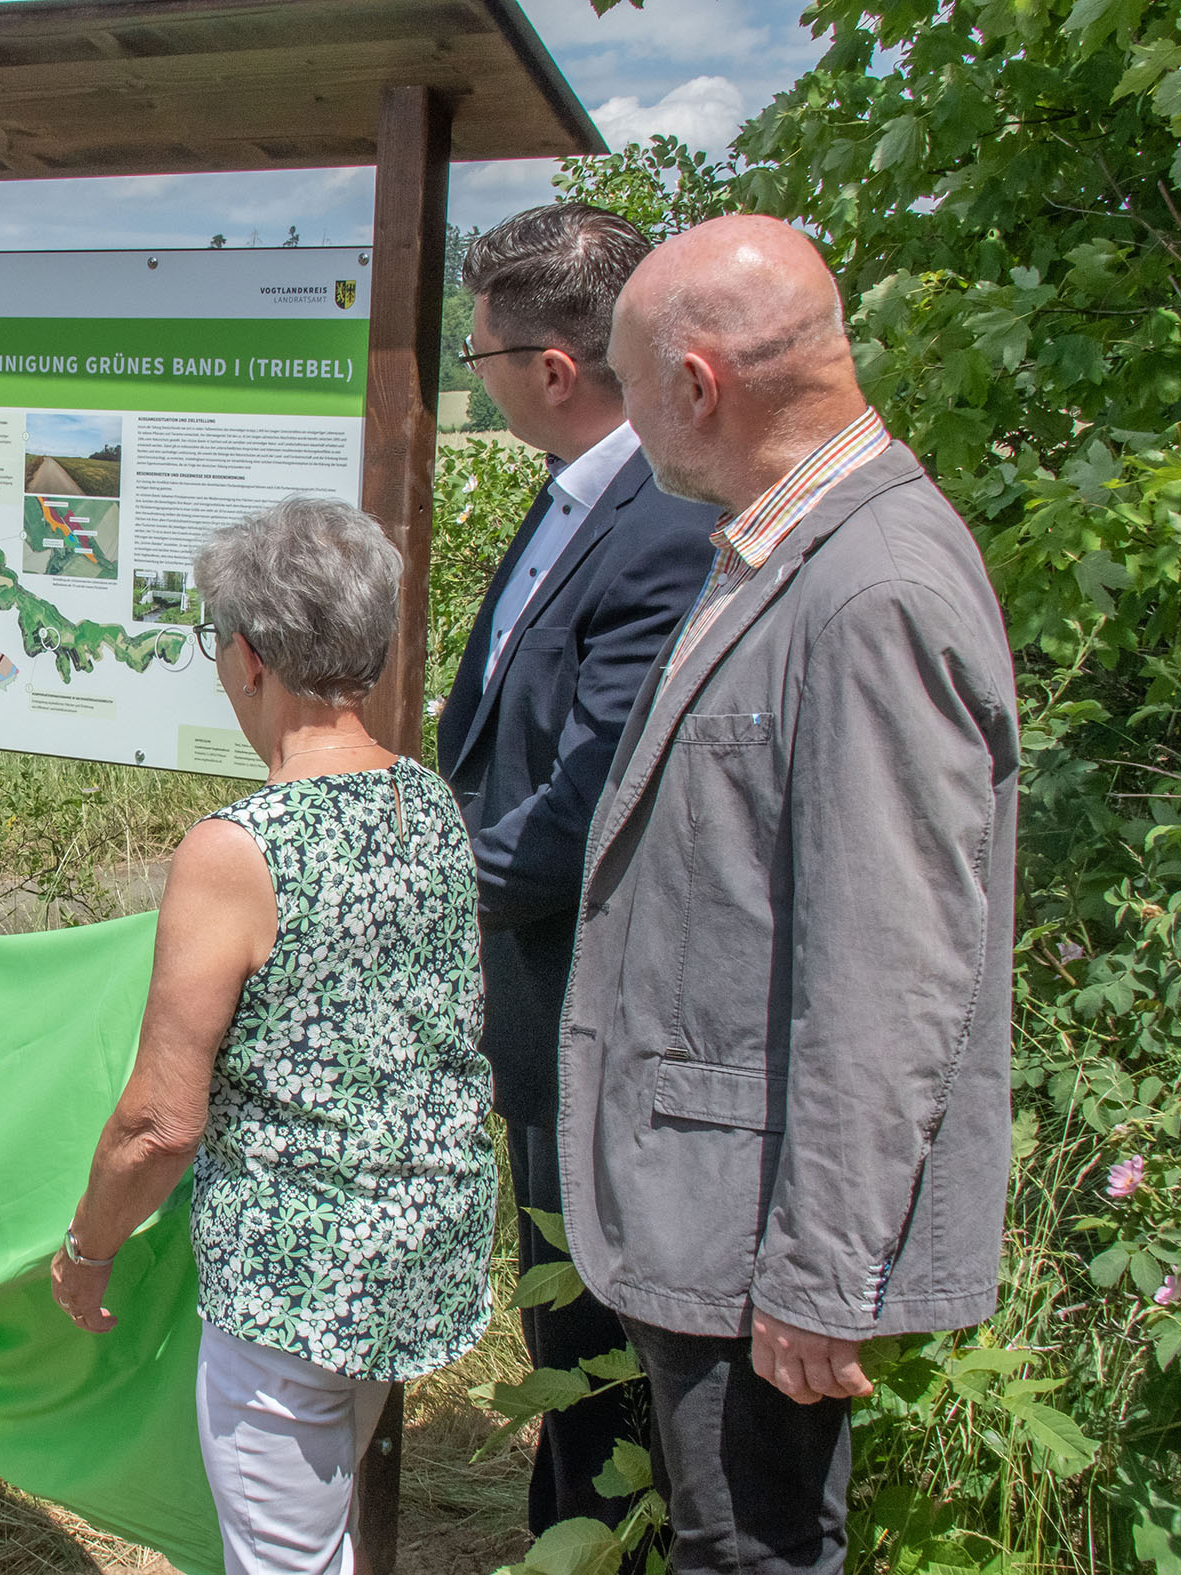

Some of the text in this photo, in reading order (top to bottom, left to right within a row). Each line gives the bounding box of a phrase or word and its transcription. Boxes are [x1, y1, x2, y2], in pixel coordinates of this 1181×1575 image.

[260, 286, 328, 294] VOGTLANDKREIS
[85, 352, 165, 375] GRÜNES
[172, 357, 227, 377] BAND
[234, 358, 240, 377] I
[249, 357, 353, 383] (TRIEBEL)
